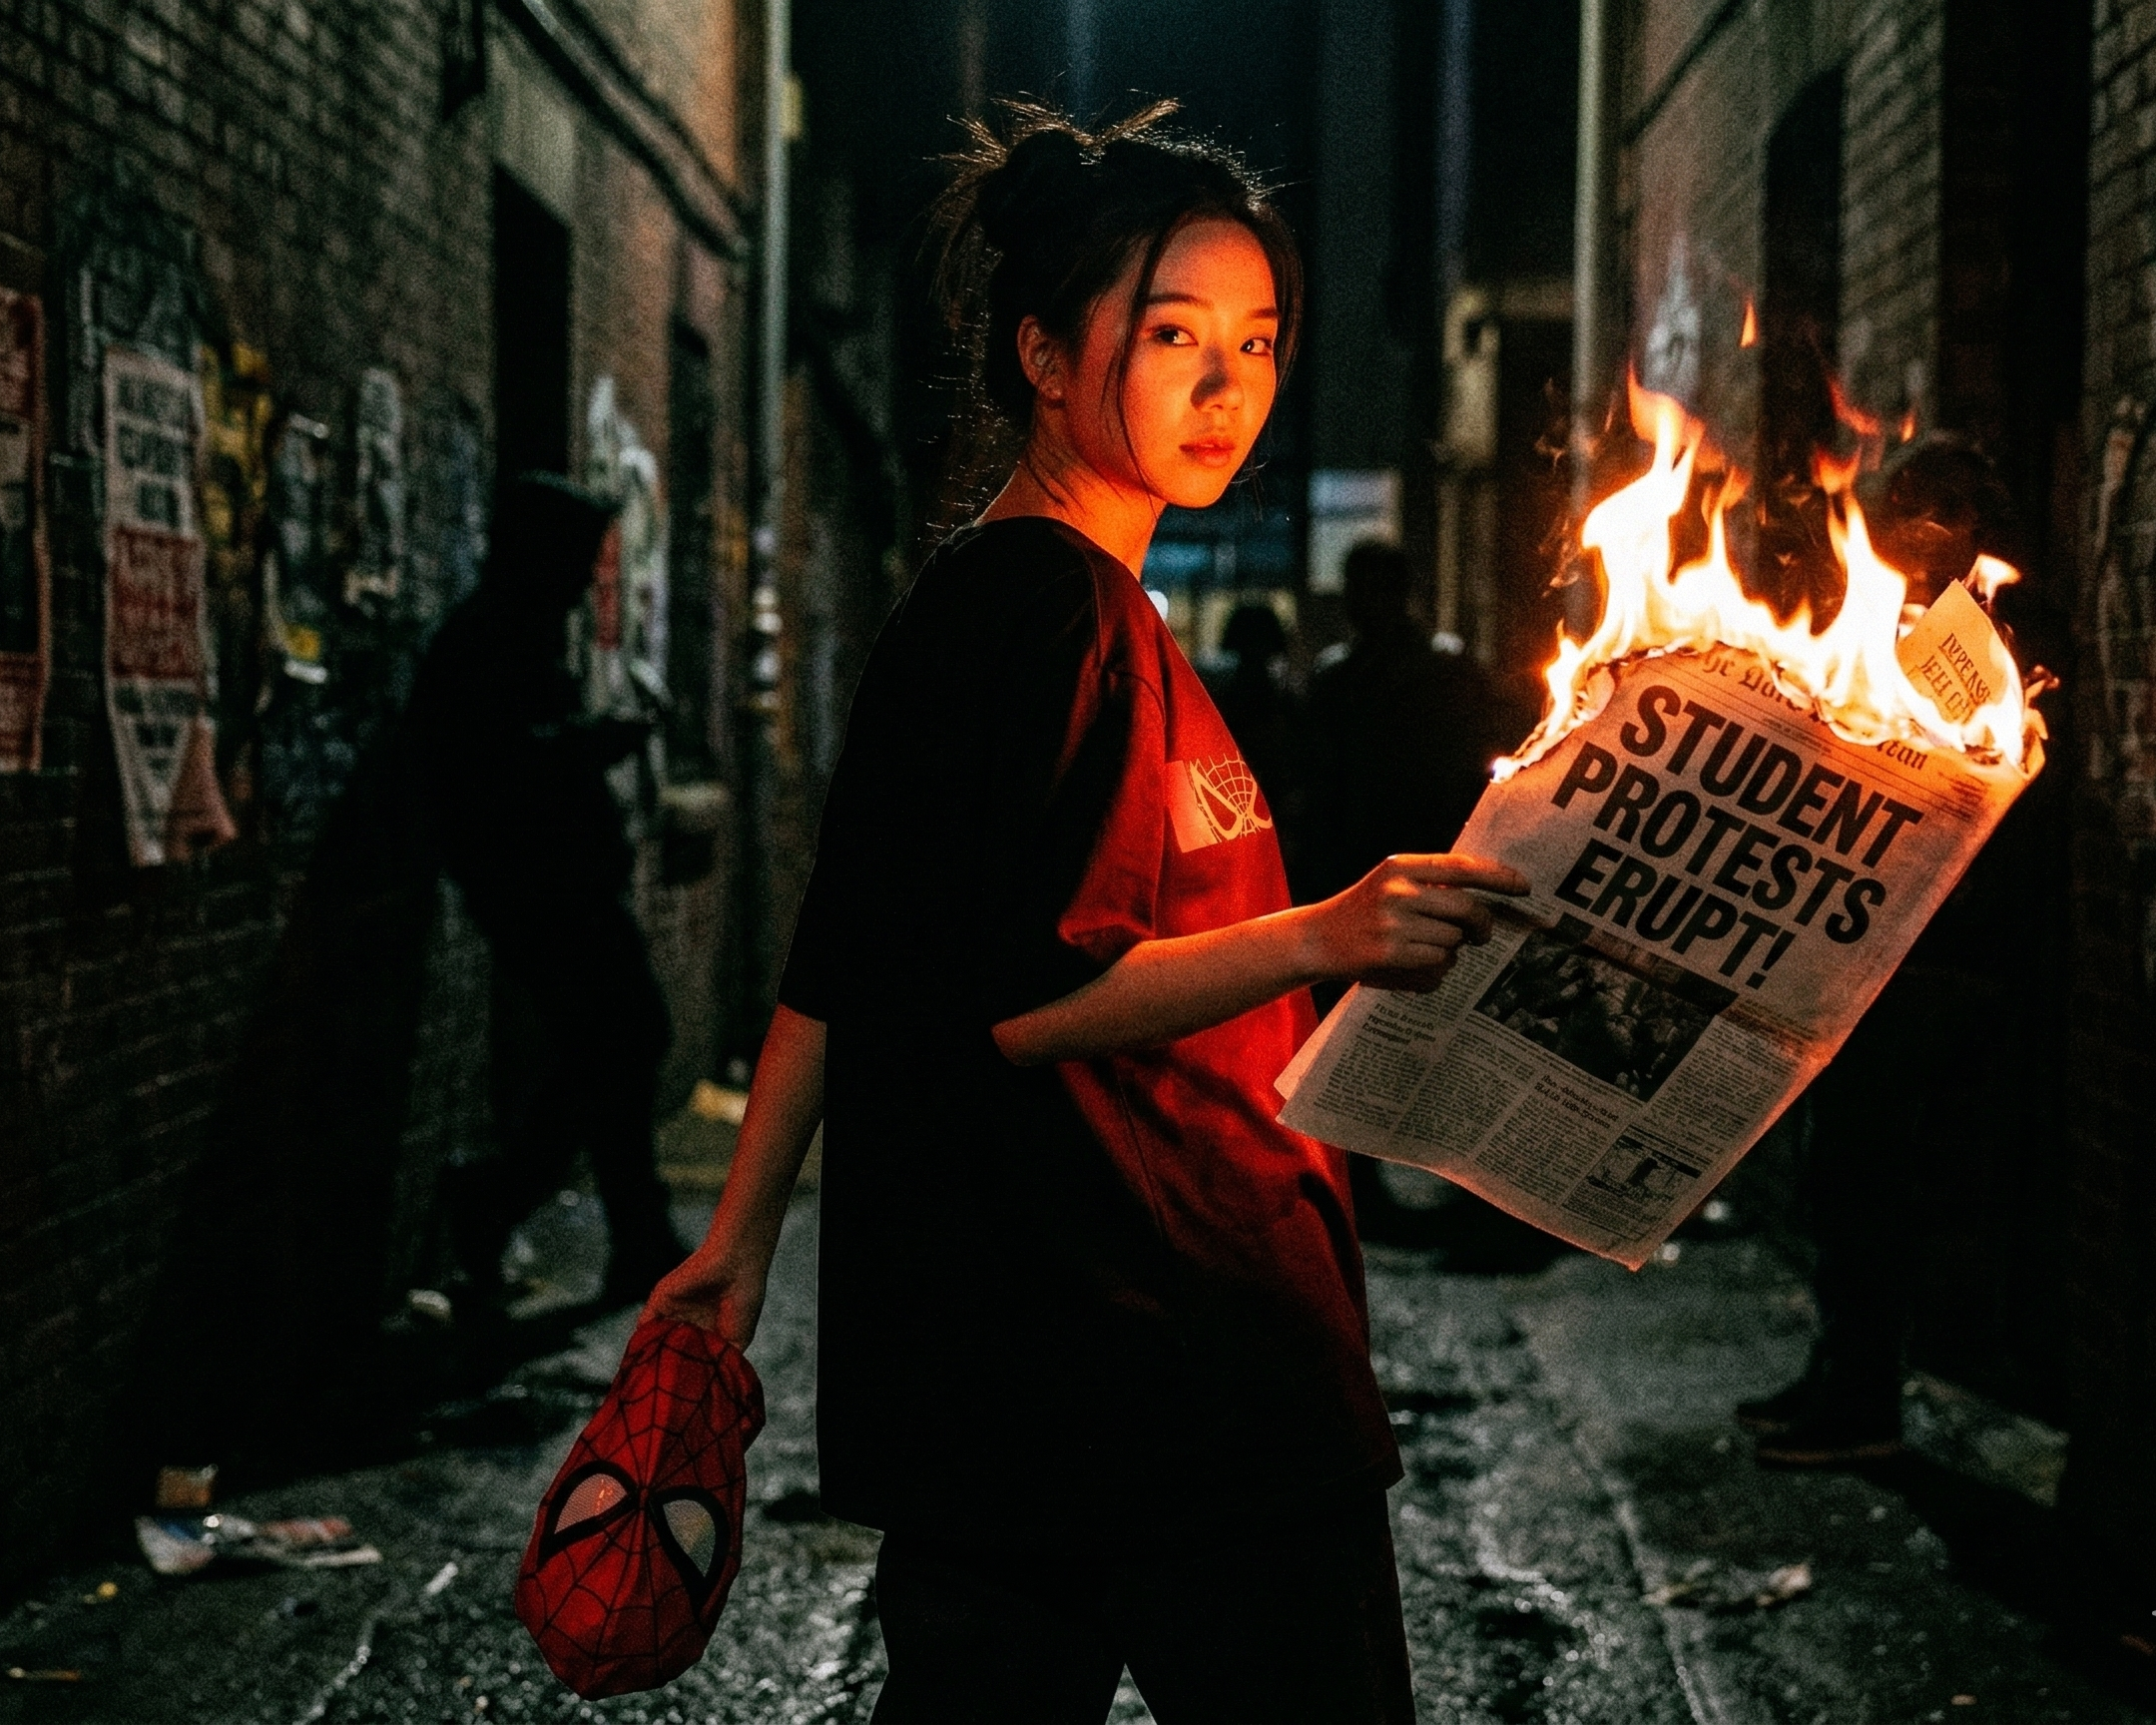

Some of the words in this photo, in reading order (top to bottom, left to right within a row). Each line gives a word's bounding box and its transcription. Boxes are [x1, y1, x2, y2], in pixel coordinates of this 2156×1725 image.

[1551, 741, 1887, 944] PROTESTS
[1620, 685, 1923, 869] STUDENT
[1553, 837, 1796, 989] ERUPT!
